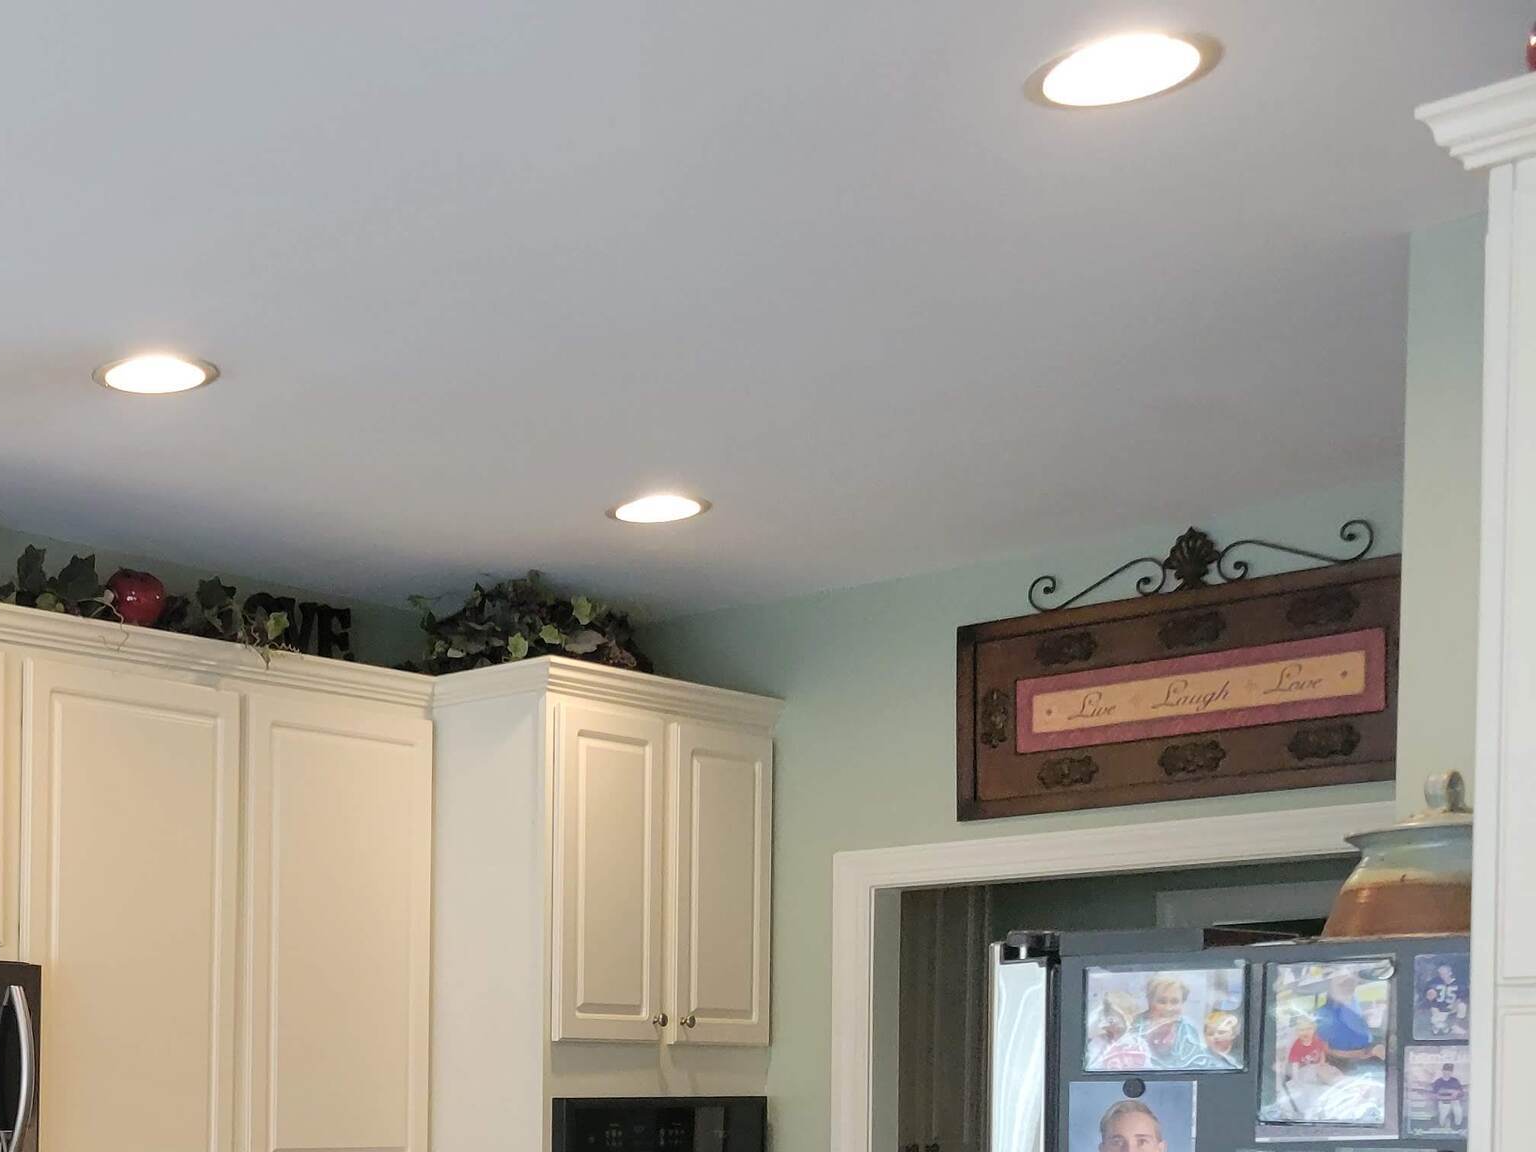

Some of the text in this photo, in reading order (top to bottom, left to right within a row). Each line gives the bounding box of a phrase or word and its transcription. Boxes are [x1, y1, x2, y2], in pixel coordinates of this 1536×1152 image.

[243, 592, 352, 660] OVE
[1067, 663, 1324, 721] Live Laugh Love
